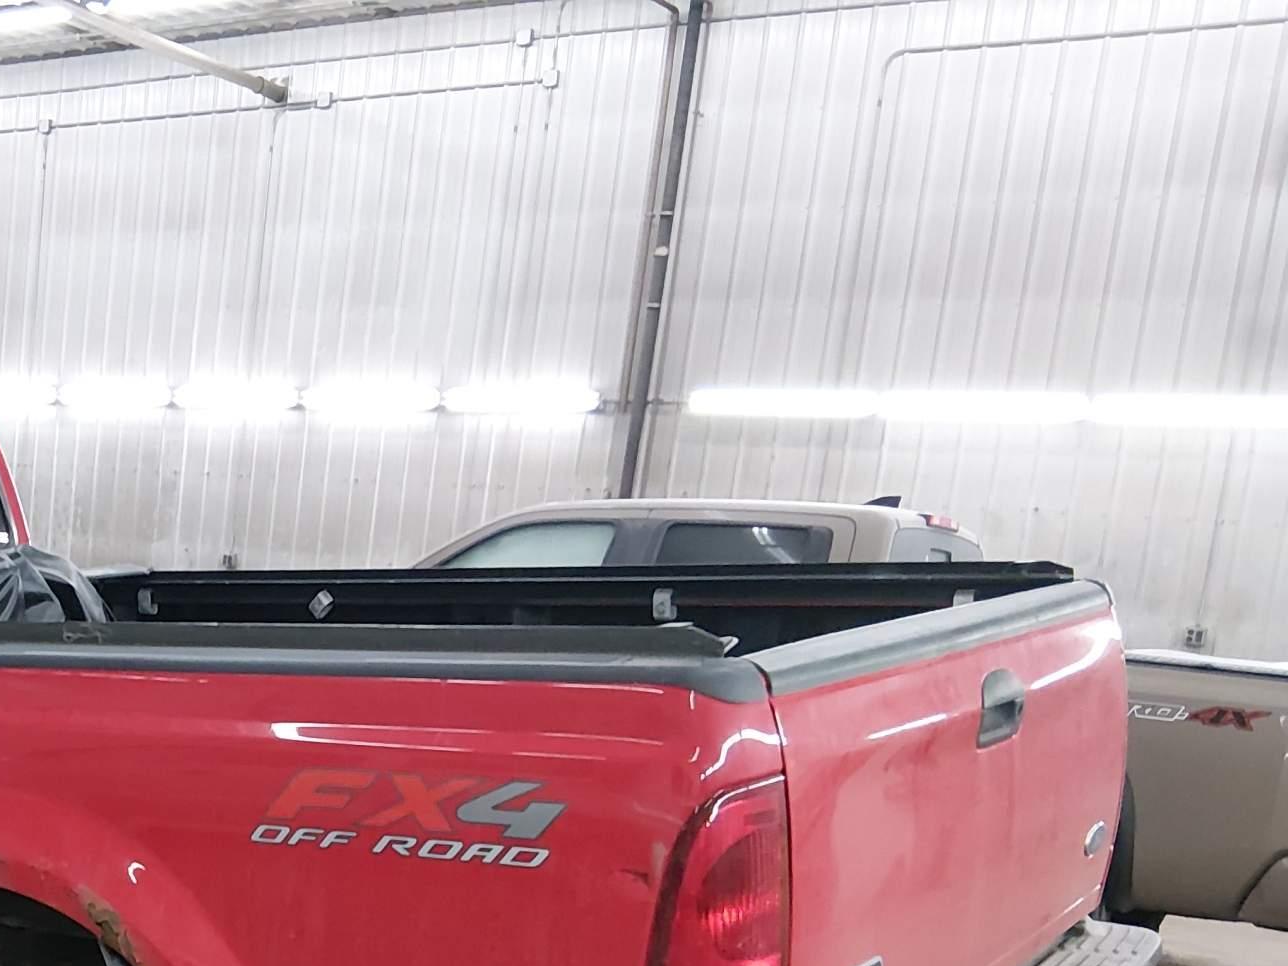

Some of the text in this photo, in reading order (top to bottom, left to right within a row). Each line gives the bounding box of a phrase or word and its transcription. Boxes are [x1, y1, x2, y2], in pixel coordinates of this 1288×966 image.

[264, 767, 568, 840] FX4
[250, 824, 551, 868] OFF ROAD
